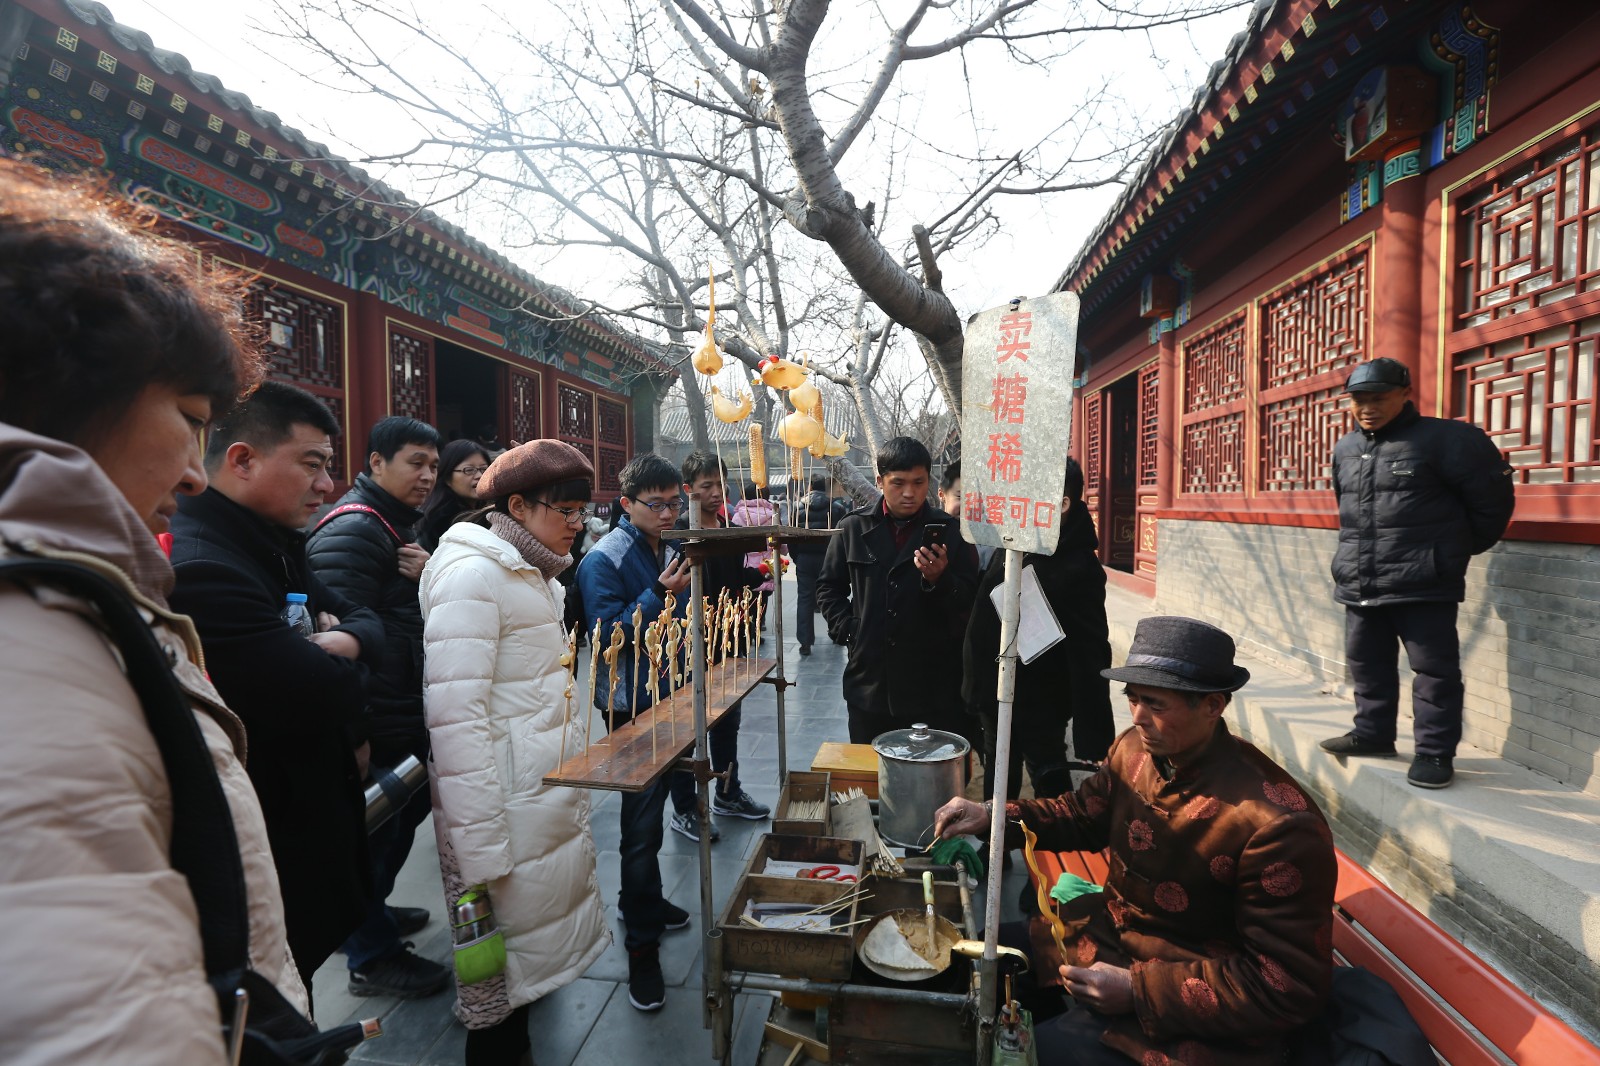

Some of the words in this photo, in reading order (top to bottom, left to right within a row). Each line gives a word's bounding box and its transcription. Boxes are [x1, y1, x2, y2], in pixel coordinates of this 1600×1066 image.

[988, 312, 1032, 484] 卖糖稀
[964, 492, 1055, 529] 甜蜜可口
